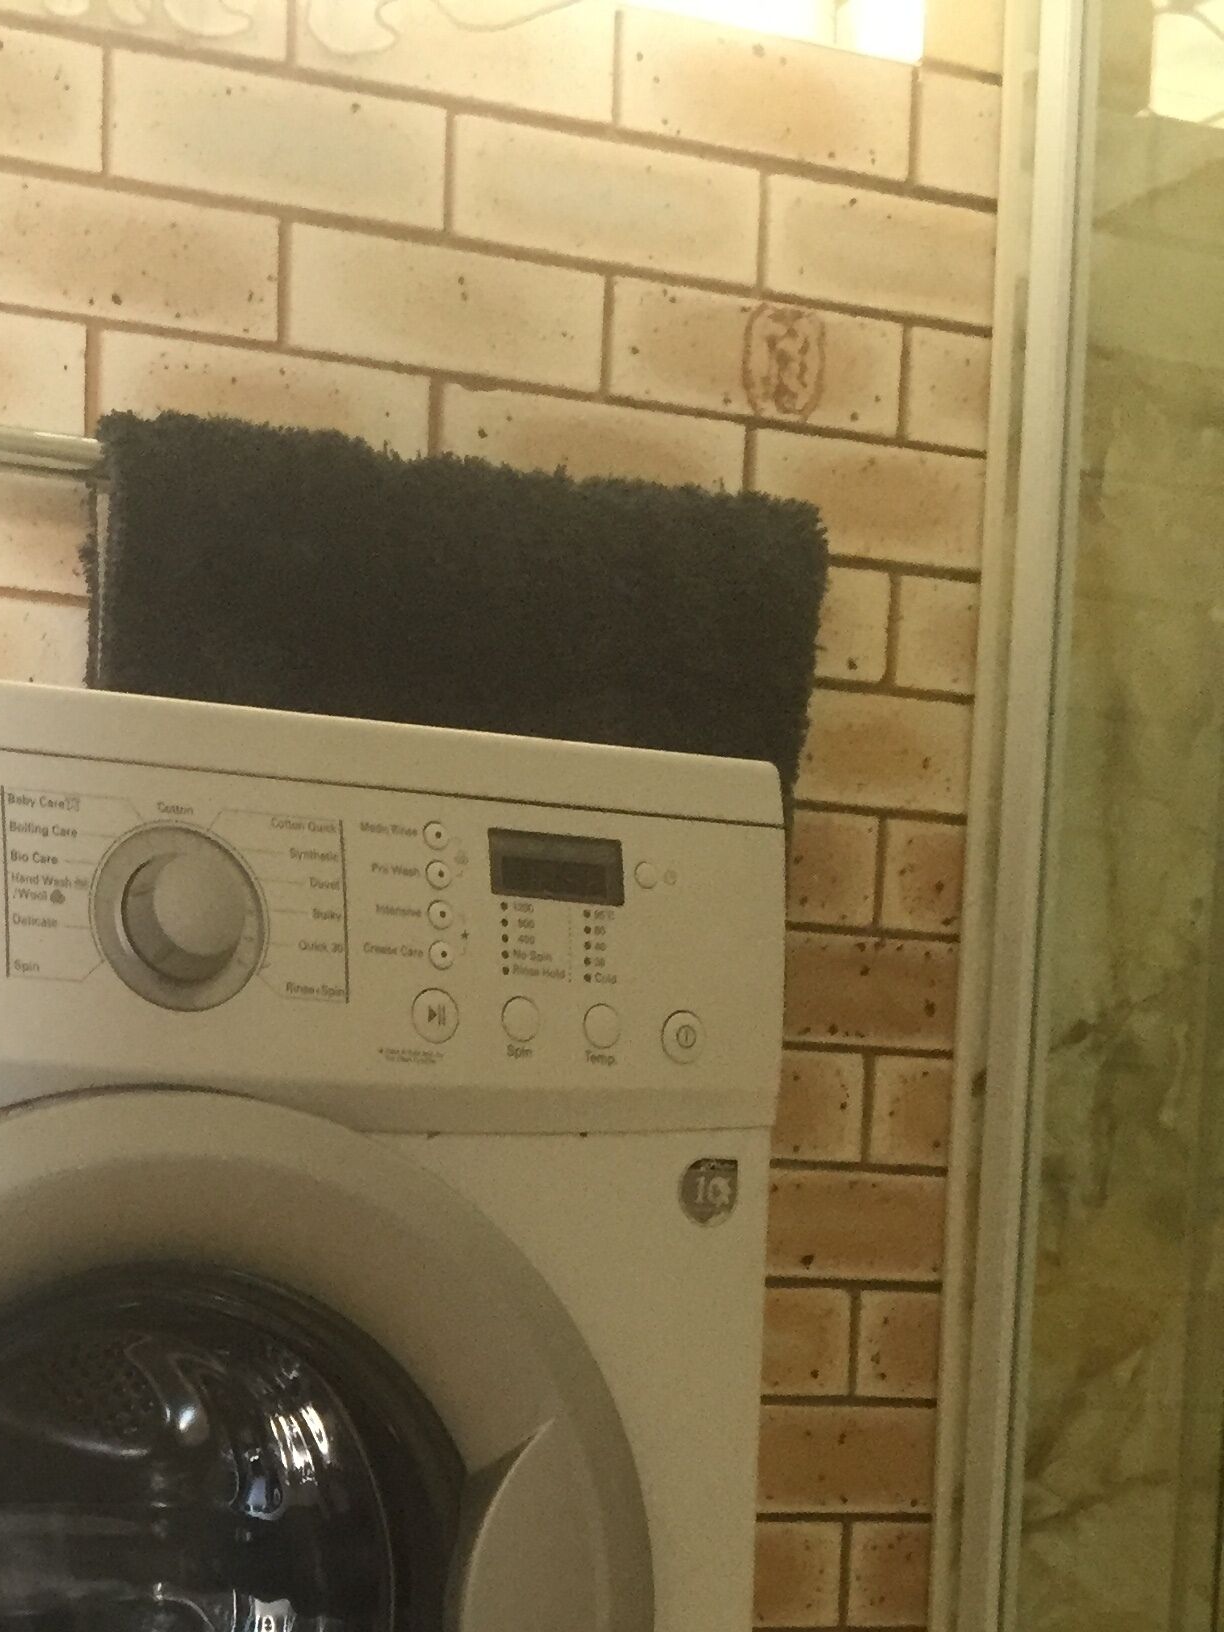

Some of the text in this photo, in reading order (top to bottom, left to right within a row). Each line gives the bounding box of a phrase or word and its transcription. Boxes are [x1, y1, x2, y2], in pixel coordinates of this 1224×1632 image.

[7, 792, 65, 810] Baby Care
[52, 824, 78, 839] Care
[271, 817, 304, 831] Cotton
[10, 848, 59, 865] Bio Care
[11, 871, 72, 889] Hand Wash
[14, 958, 40, 973] Spin
[506, 1043, 533, 1059] Spin
